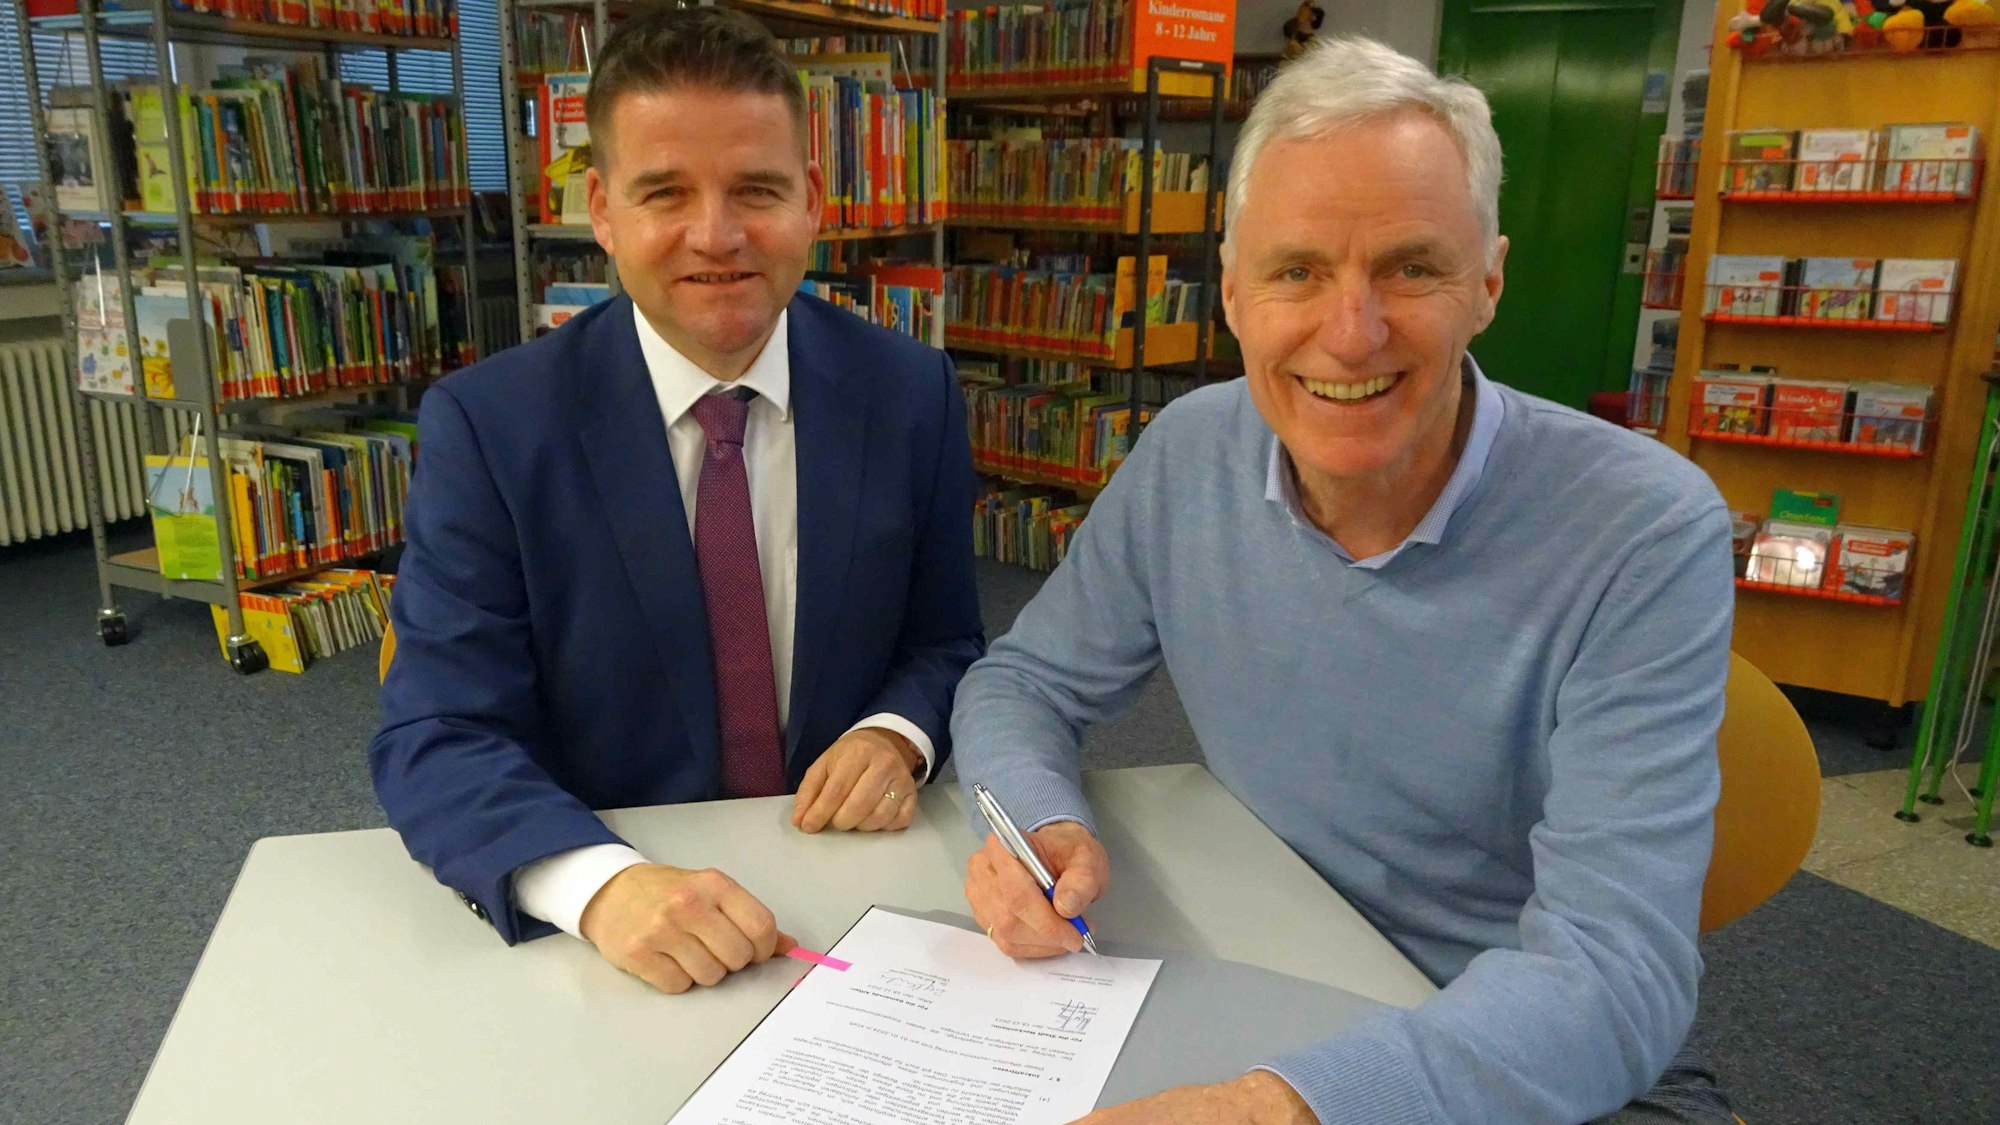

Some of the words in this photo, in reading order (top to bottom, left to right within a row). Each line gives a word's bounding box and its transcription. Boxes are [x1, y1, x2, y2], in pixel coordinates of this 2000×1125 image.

[1148, 0, 1225, 22] Kinderromane
[1155, 22, 1163, 35] 8
[1173, 23, 1186, 39] 12
[1187, 25, 1217, 42] Jahre
